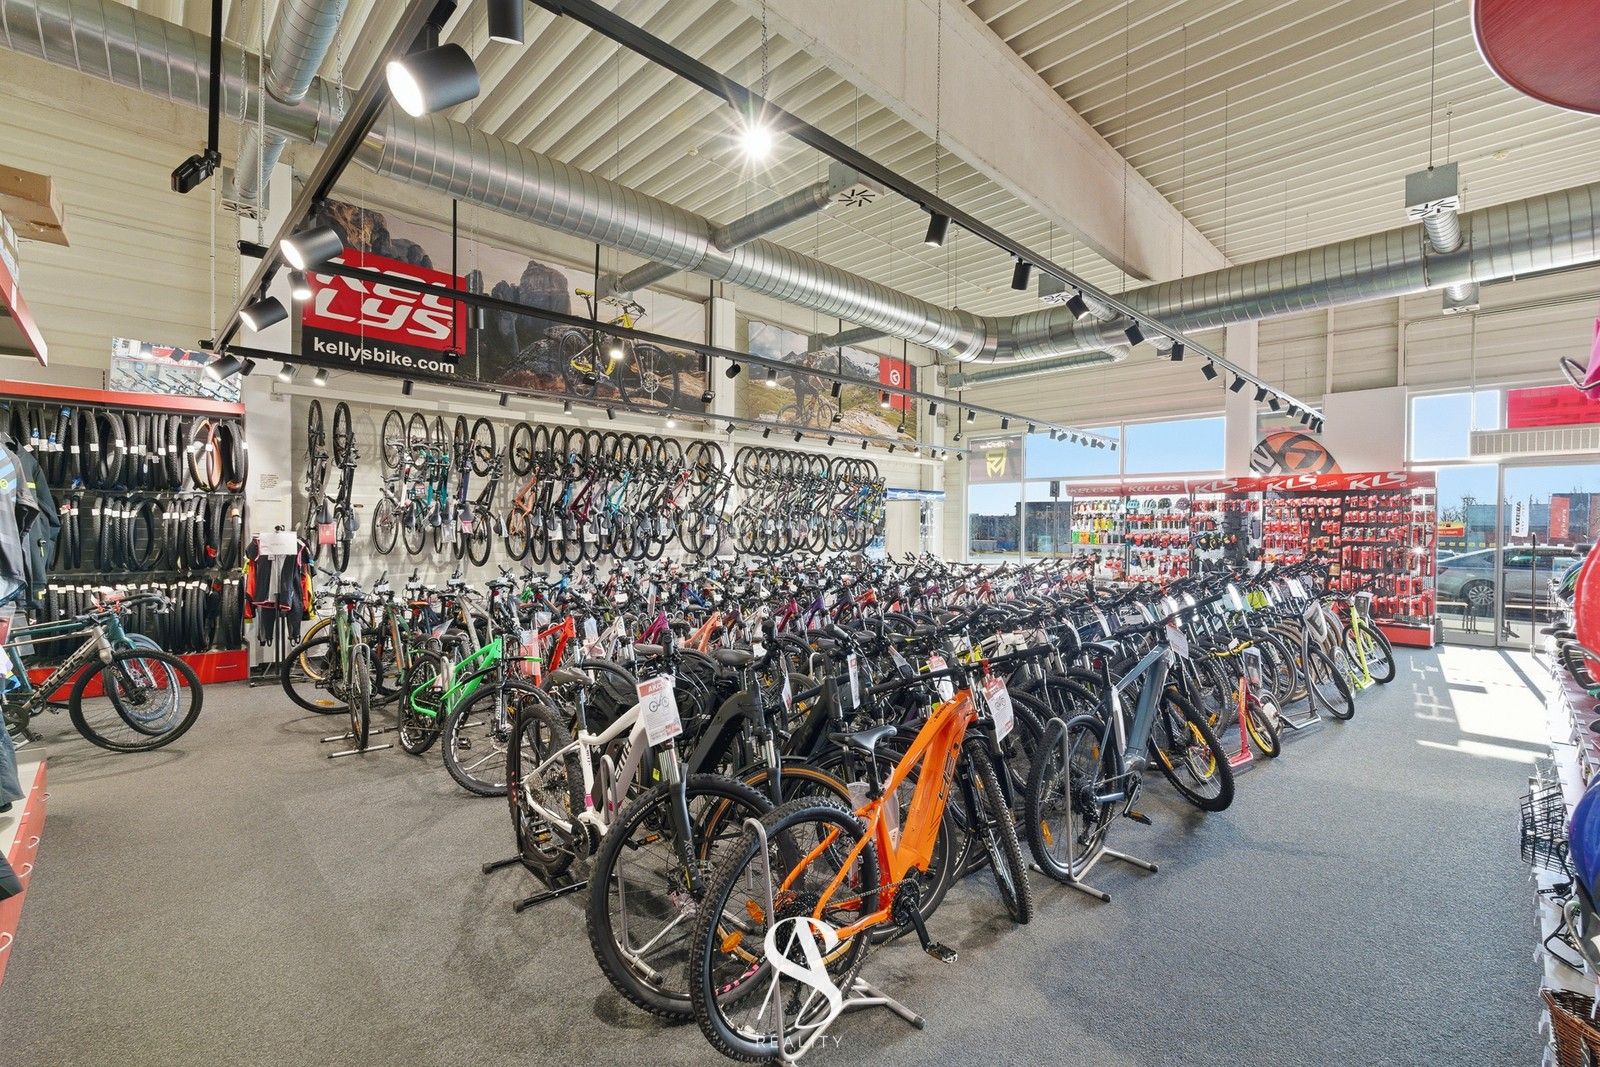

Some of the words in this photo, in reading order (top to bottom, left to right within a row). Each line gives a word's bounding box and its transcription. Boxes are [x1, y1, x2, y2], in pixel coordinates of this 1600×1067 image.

[313, 336, 455, 374] kellysbike.com
[1266, 473, 1318, 492] KLS
[1350, 471, 1408, 490] KLS
